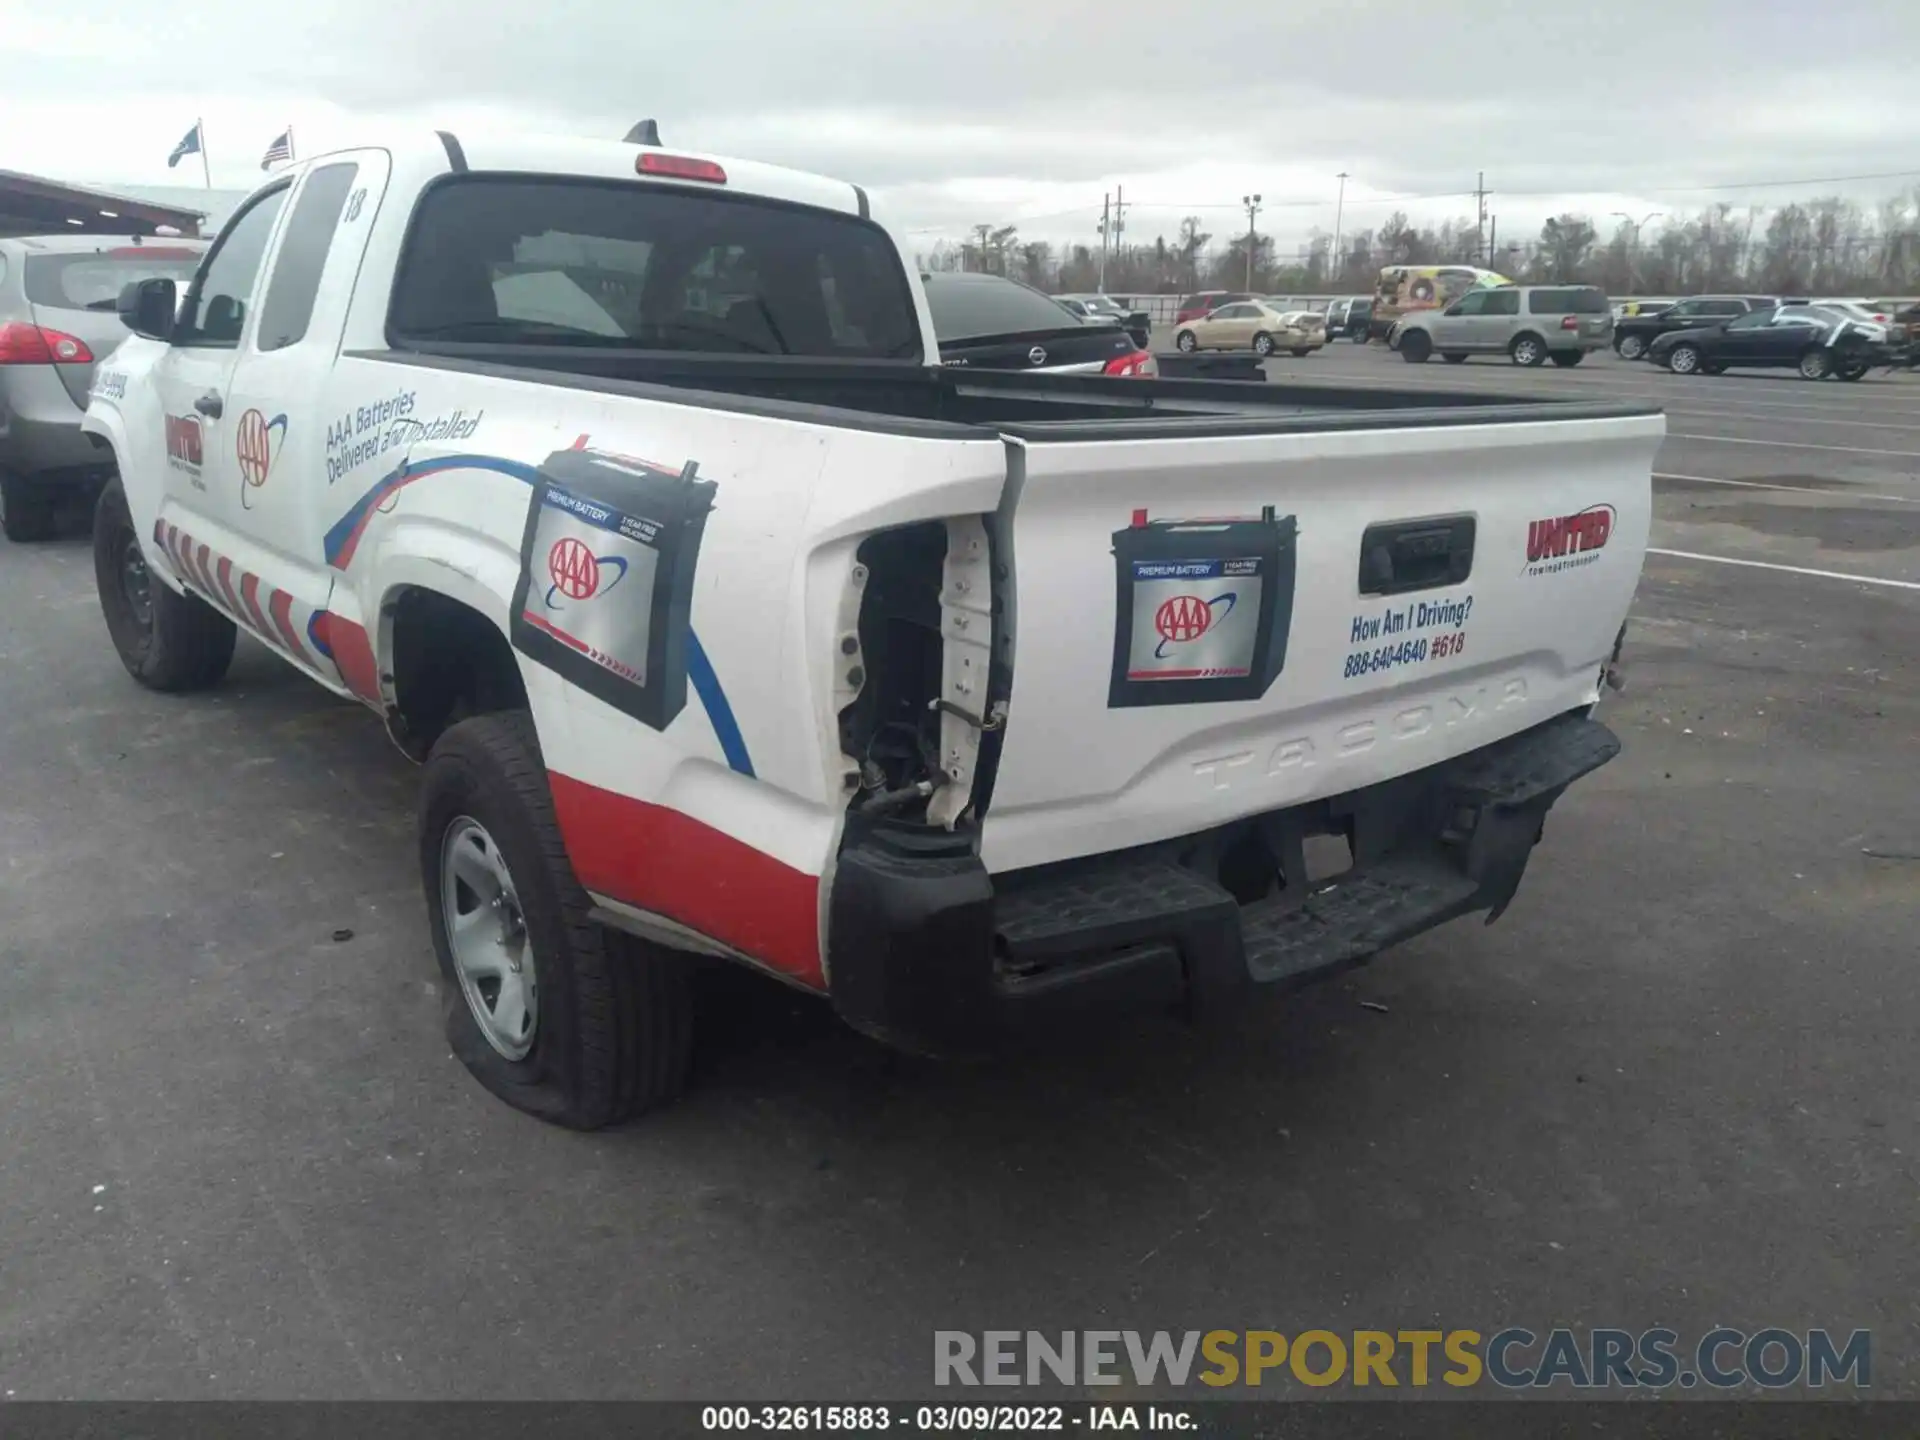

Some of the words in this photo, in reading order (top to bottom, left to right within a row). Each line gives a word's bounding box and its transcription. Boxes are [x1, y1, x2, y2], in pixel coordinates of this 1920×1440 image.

[326, 413, 353, 454] AAA
[355, 389, 416, 434] Batteries
[327, 427, 381, 485] Delivered
[546, 488, 576, 511] PREMIUM
[574, 500, 611, 522] BATTERY
[1526, 510, 1610, 562] UNITED
[549, 537, 599, 600] AAA
[1138, 565, 1176, 576] PREMIUM
[1175, 564, 1212, 575] BATTERY
[1156, 595, 1212, 642] AAA
[1350, 615, 1381, 644] How
[1383, 608, 1404, 636] Am
[1407, 603, 1414, 630] I
[1416, 594, 1473, 628] Driving?
[1344, 637, 1428, 679] 888-640-4640
[1430, 631, 1466, 661] #618
